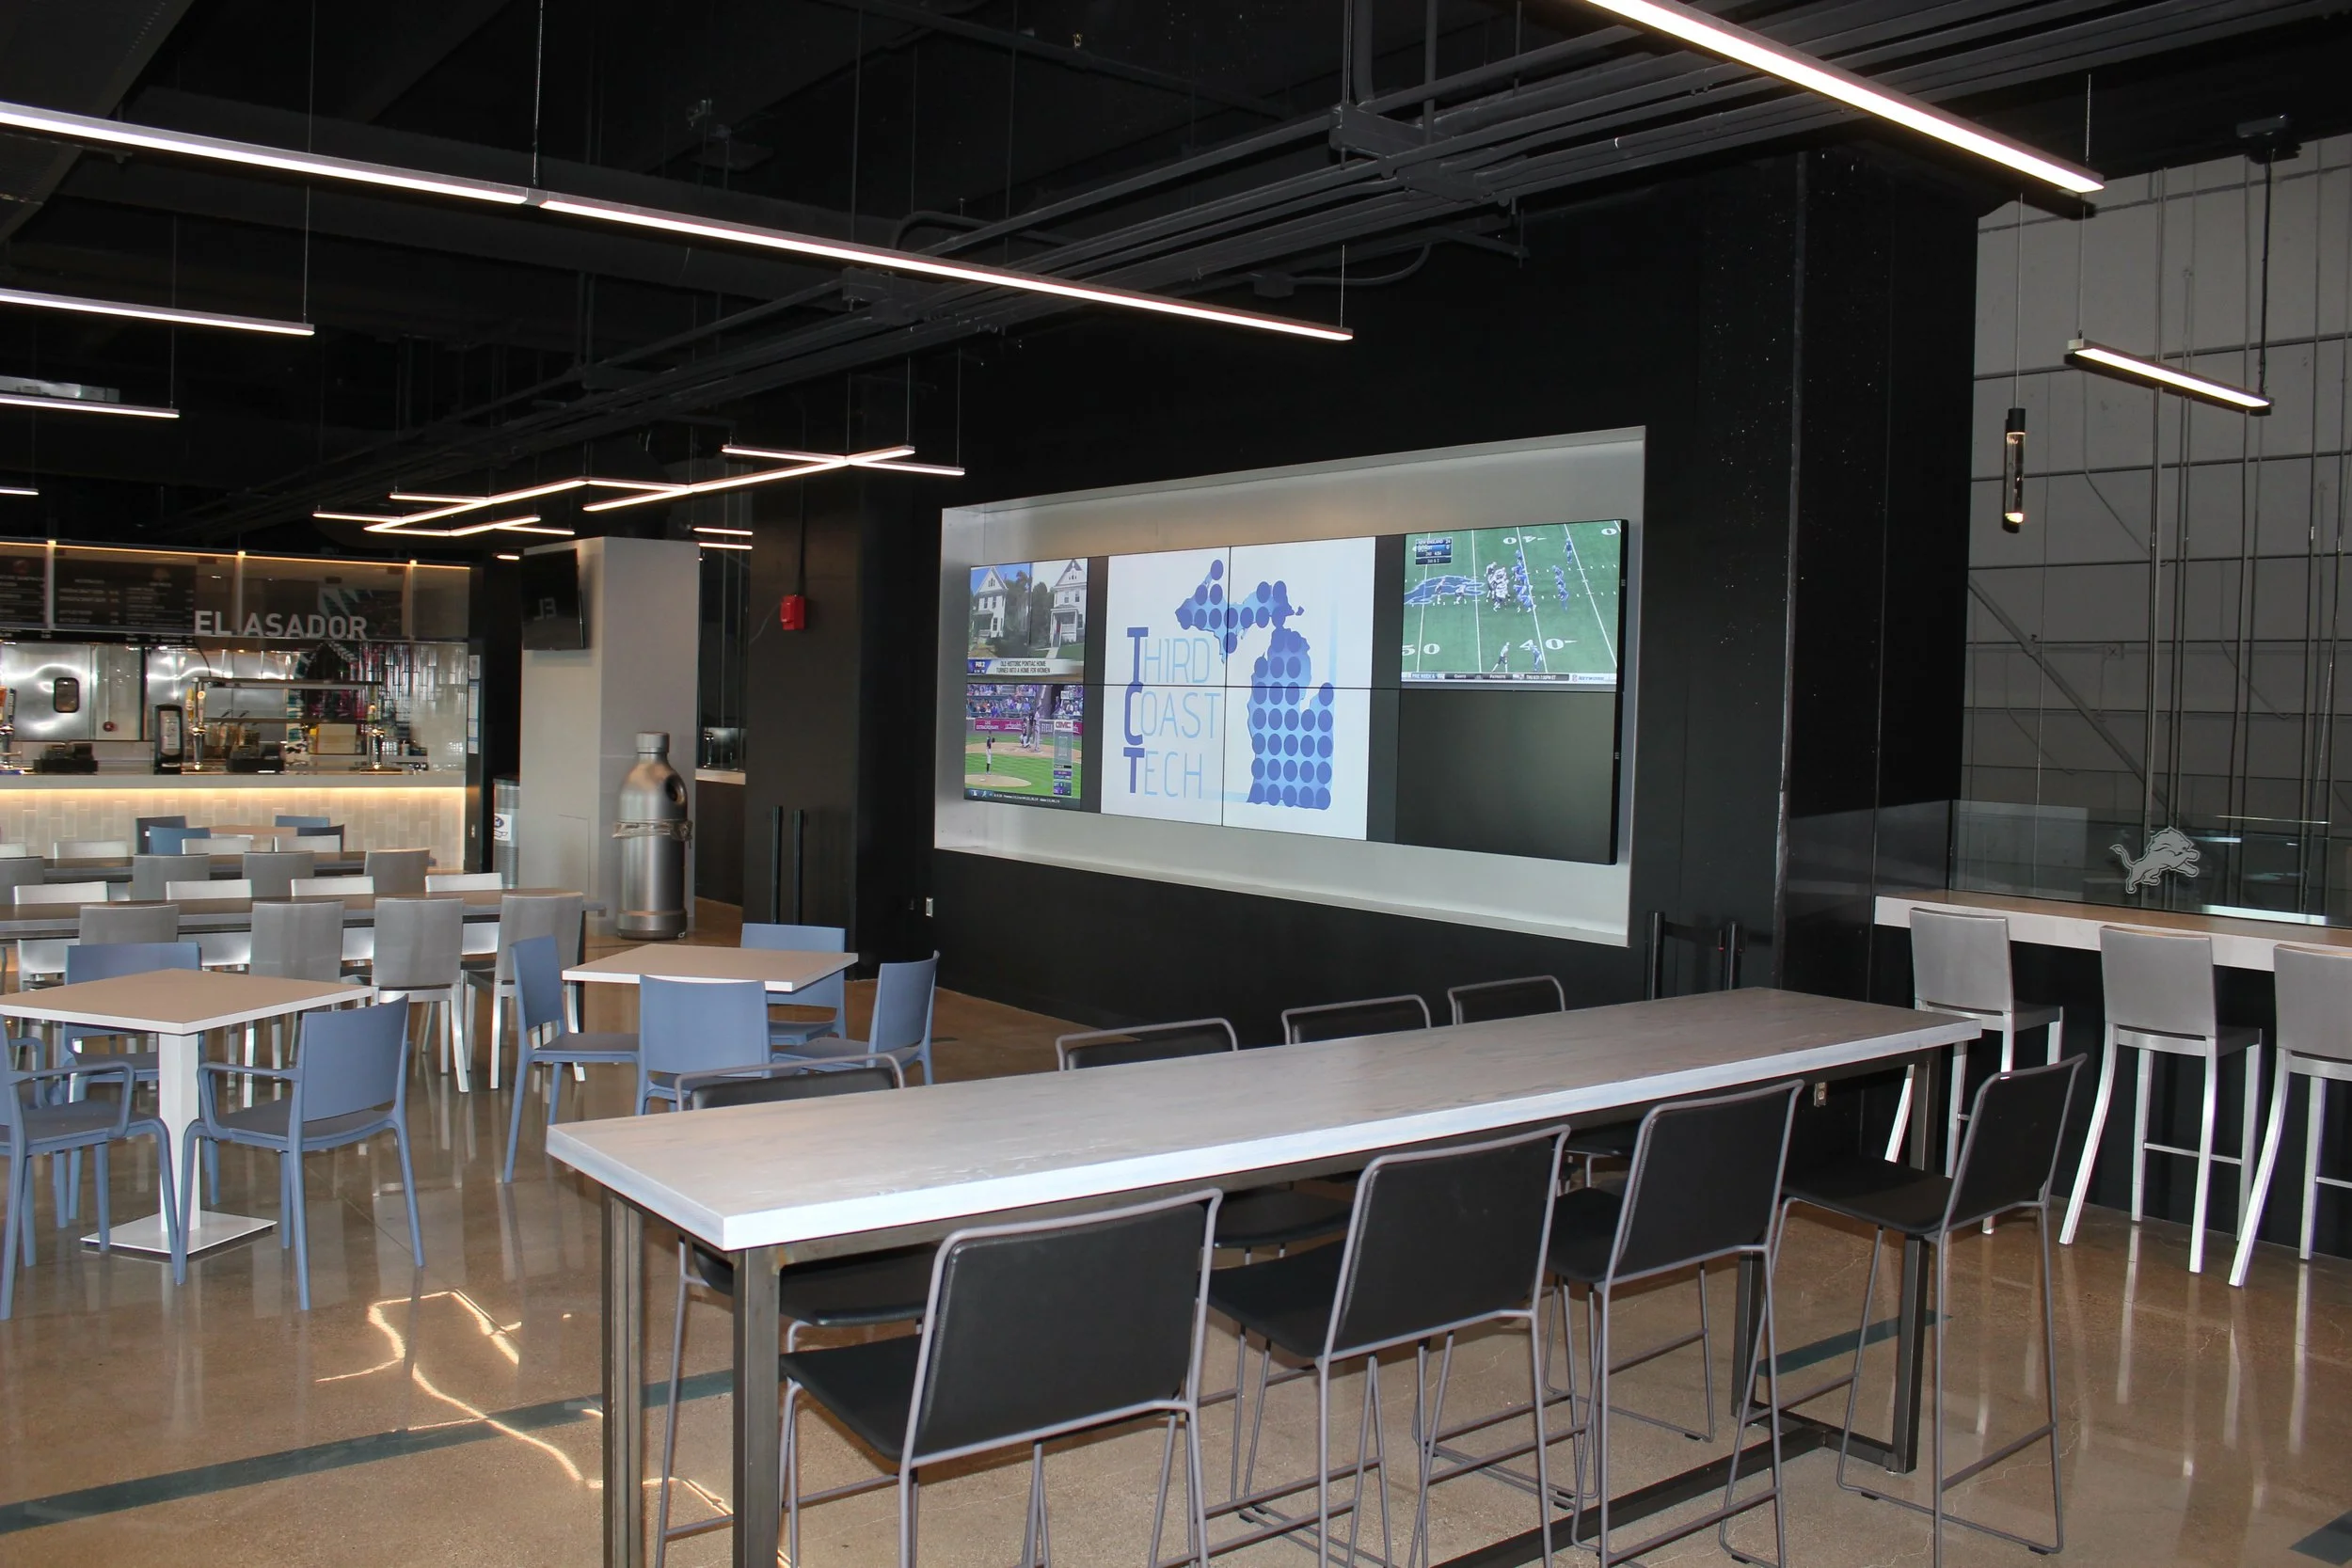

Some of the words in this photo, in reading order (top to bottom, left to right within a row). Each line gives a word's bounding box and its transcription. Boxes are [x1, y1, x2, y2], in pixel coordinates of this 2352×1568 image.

[195, 610, 232, 636] EL
[243, 612, 368, 640] ASADOR
[1127, 626, 1211, 684] THIRD
[1123, 681, 1221, 746] COAST
[1123, 747, 1203, 800] TECH
